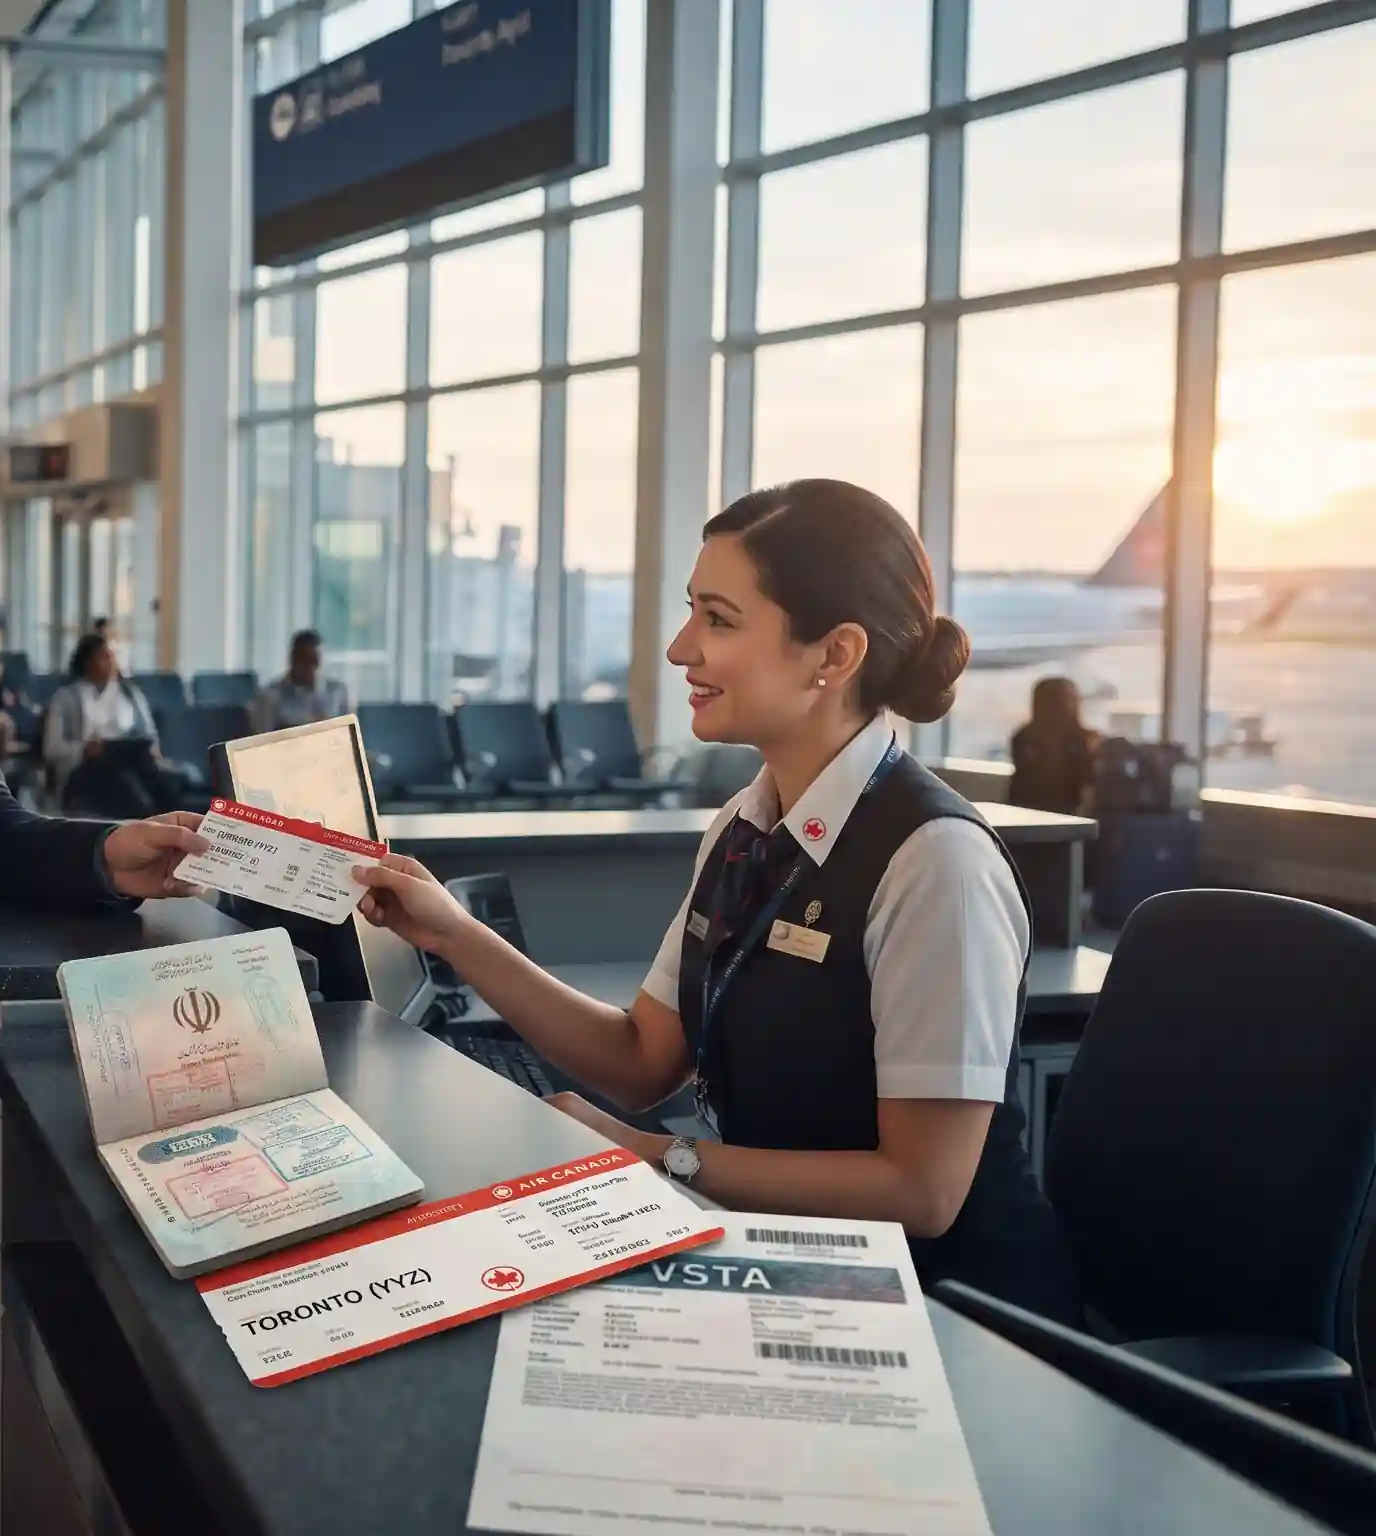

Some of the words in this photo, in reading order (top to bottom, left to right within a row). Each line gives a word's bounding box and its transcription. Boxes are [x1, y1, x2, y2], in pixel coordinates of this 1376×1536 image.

[519, 1176, 549, 1191] AIR
[551, 1154, 623, 1180] CANADA
[652, 1262, 772, 1290] VSTA
[240, 1289, 363, 1336] TORONTO
[369, 1267, 432, 1299] (YYZ)
